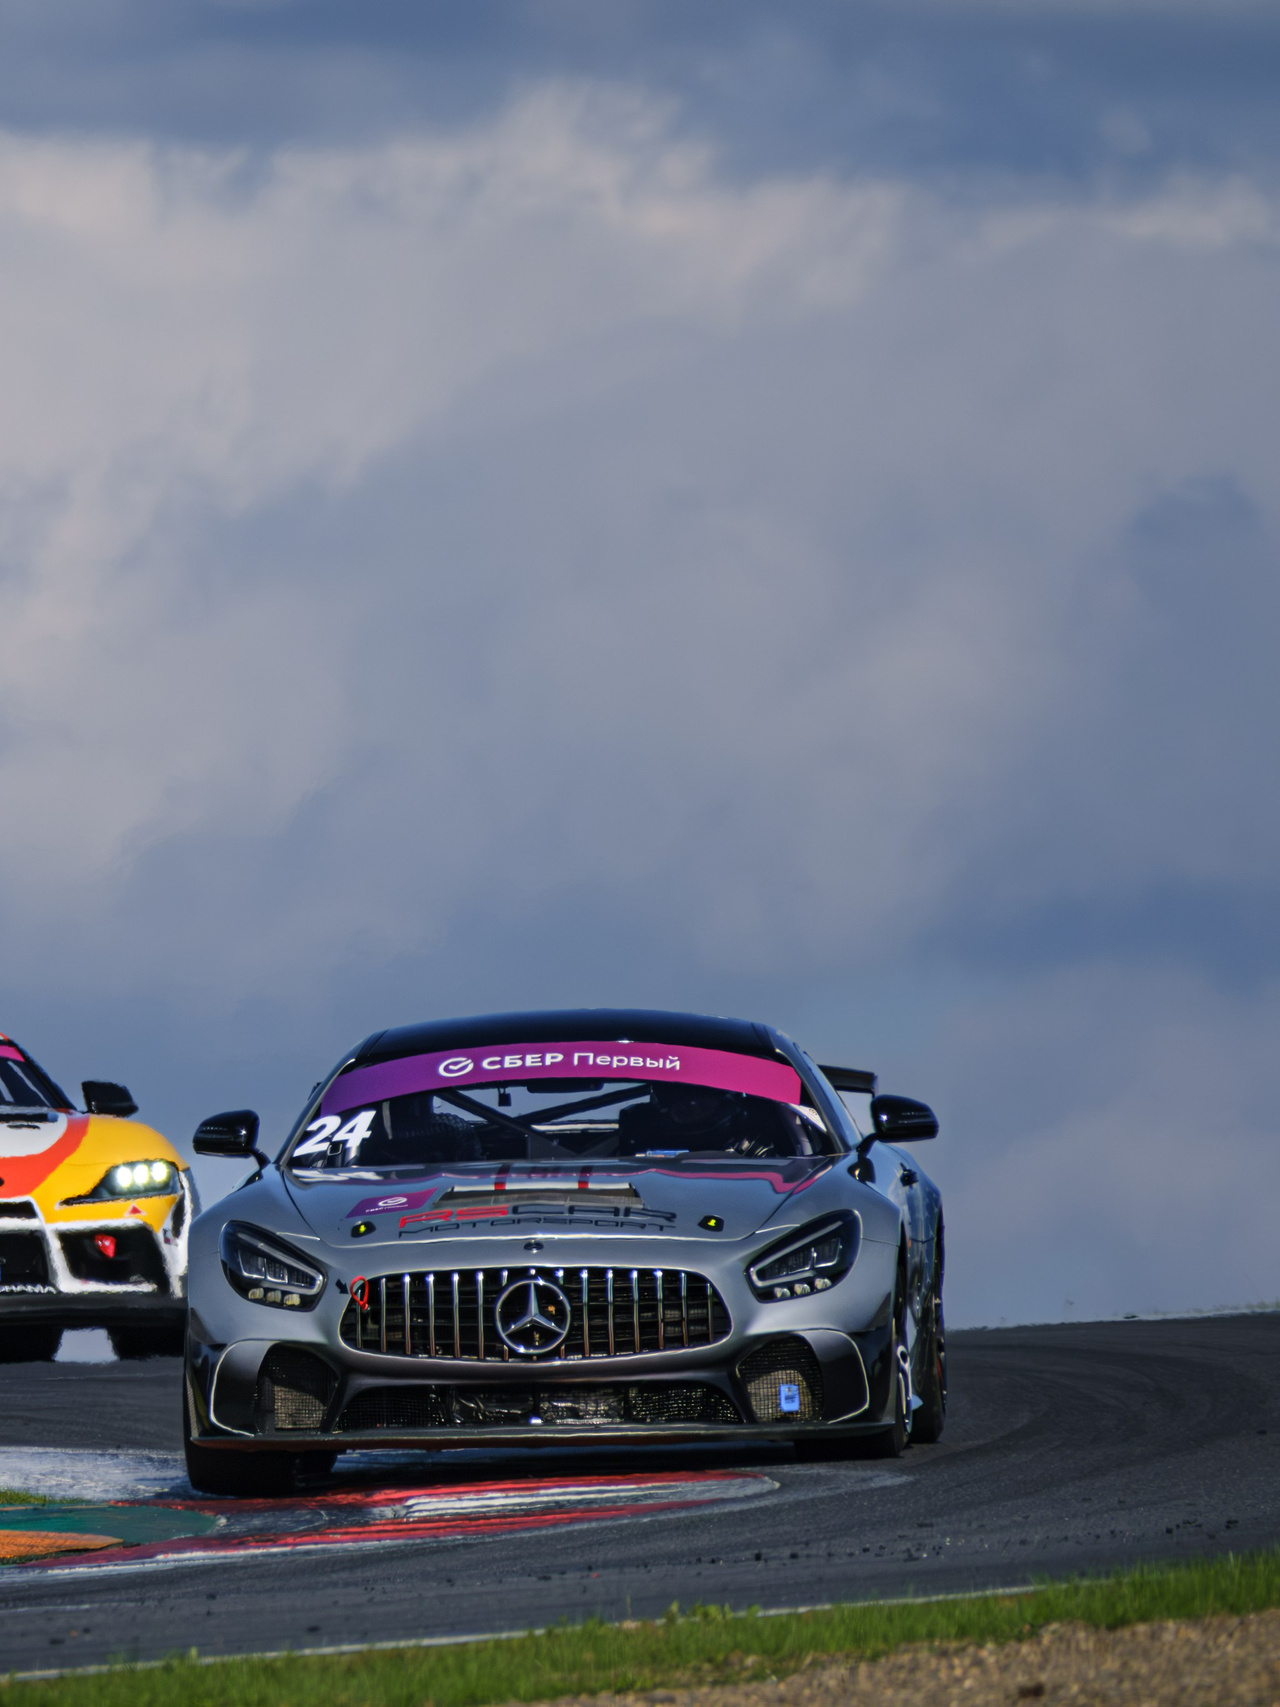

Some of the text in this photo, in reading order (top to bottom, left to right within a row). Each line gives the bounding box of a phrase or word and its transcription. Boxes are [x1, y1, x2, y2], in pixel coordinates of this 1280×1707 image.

[481, 1052, 681, 1071] СБЕР Первый
[292, 1110, 377, 1158] 24
